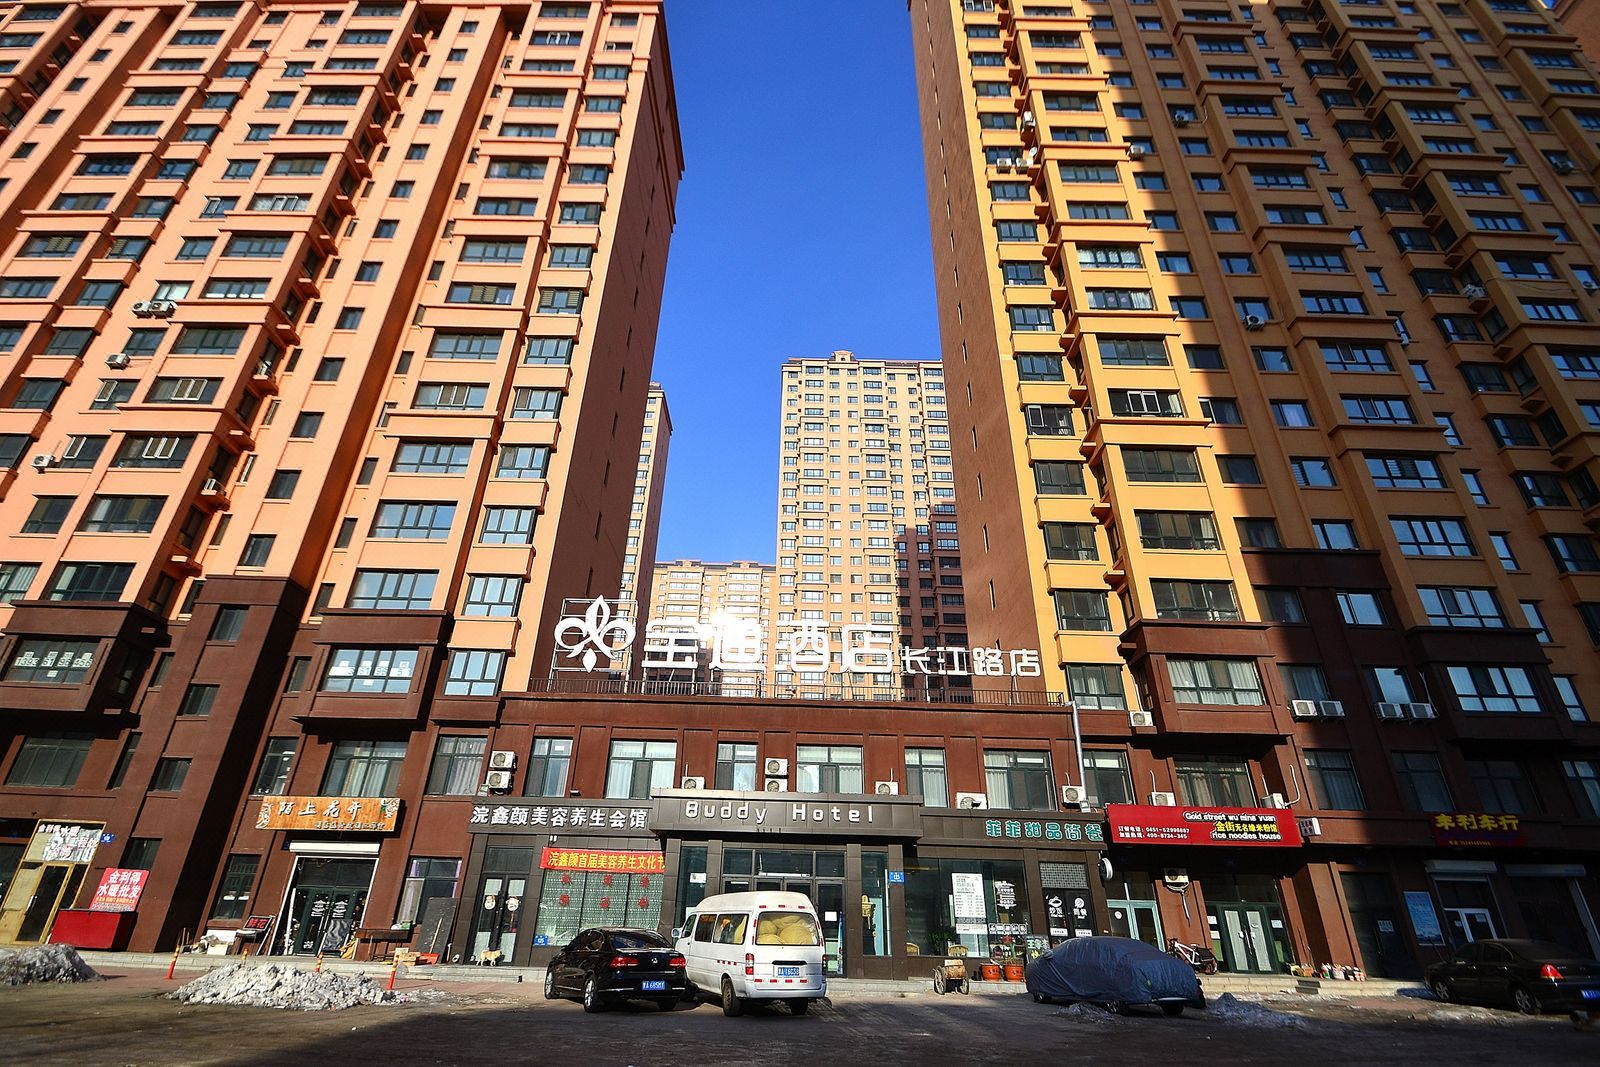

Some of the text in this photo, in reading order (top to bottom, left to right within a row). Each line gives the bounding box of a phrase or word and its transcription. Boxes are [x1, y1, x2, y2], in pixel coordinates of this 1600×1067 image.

[901, 645, 1041, 677] 长江路店
[470, 806, 648, 829] 浣鑫颜美容养生会馆
[685, 800, 875, 824] Buddy Hotel
[1185, 812, 1202, 821] Gold
[1203, 813, 1226, 821] street
[1227, 814, 1239, 822] wu
[985, 819, 1104, 841] 菲菲甜品简餐
[1212, 832, 1282, 841] rice noodles house
[107, 869, 143, 886] 金利得
[96, 881, 142, 899] 水暖批发
